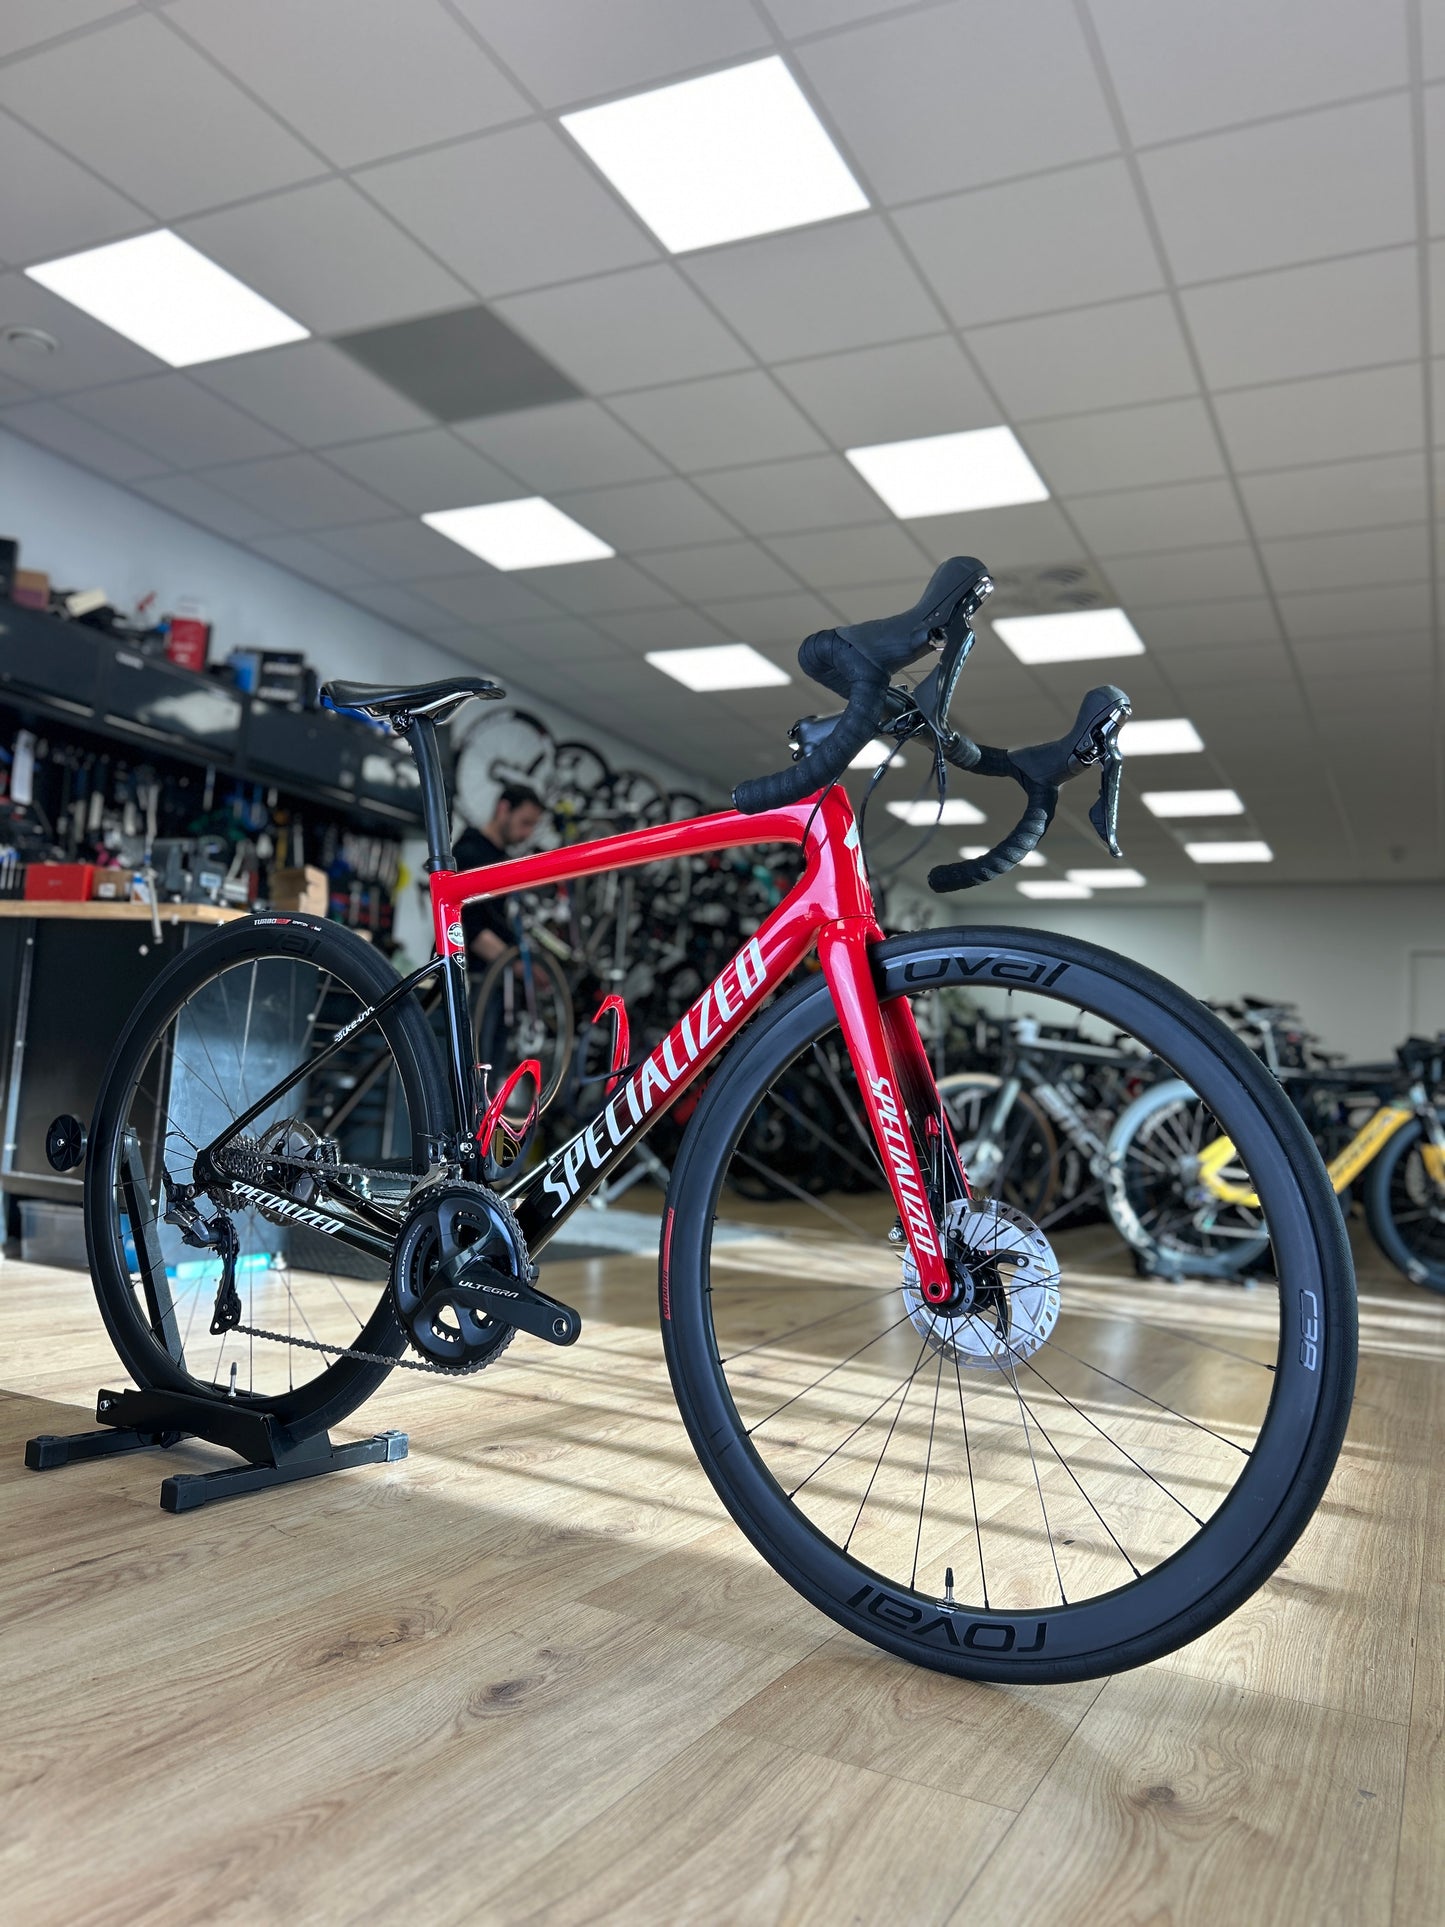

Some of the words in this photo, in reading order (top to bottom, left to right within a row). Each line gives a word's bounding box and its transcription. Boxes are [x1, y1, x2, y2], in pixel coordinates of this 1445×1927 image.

[543, 937, 767, 1218] SPECIALIZED
[866, 1070, 937, 1257] SPECIALIZED
[226, 1181, 345, 1235] SPECIALIZED
[458, 1280, 520, 1299] ULTEGRA
[1299, 1289, 1318, 1372] C38
[846, 1584, 1048, 1653] roval
